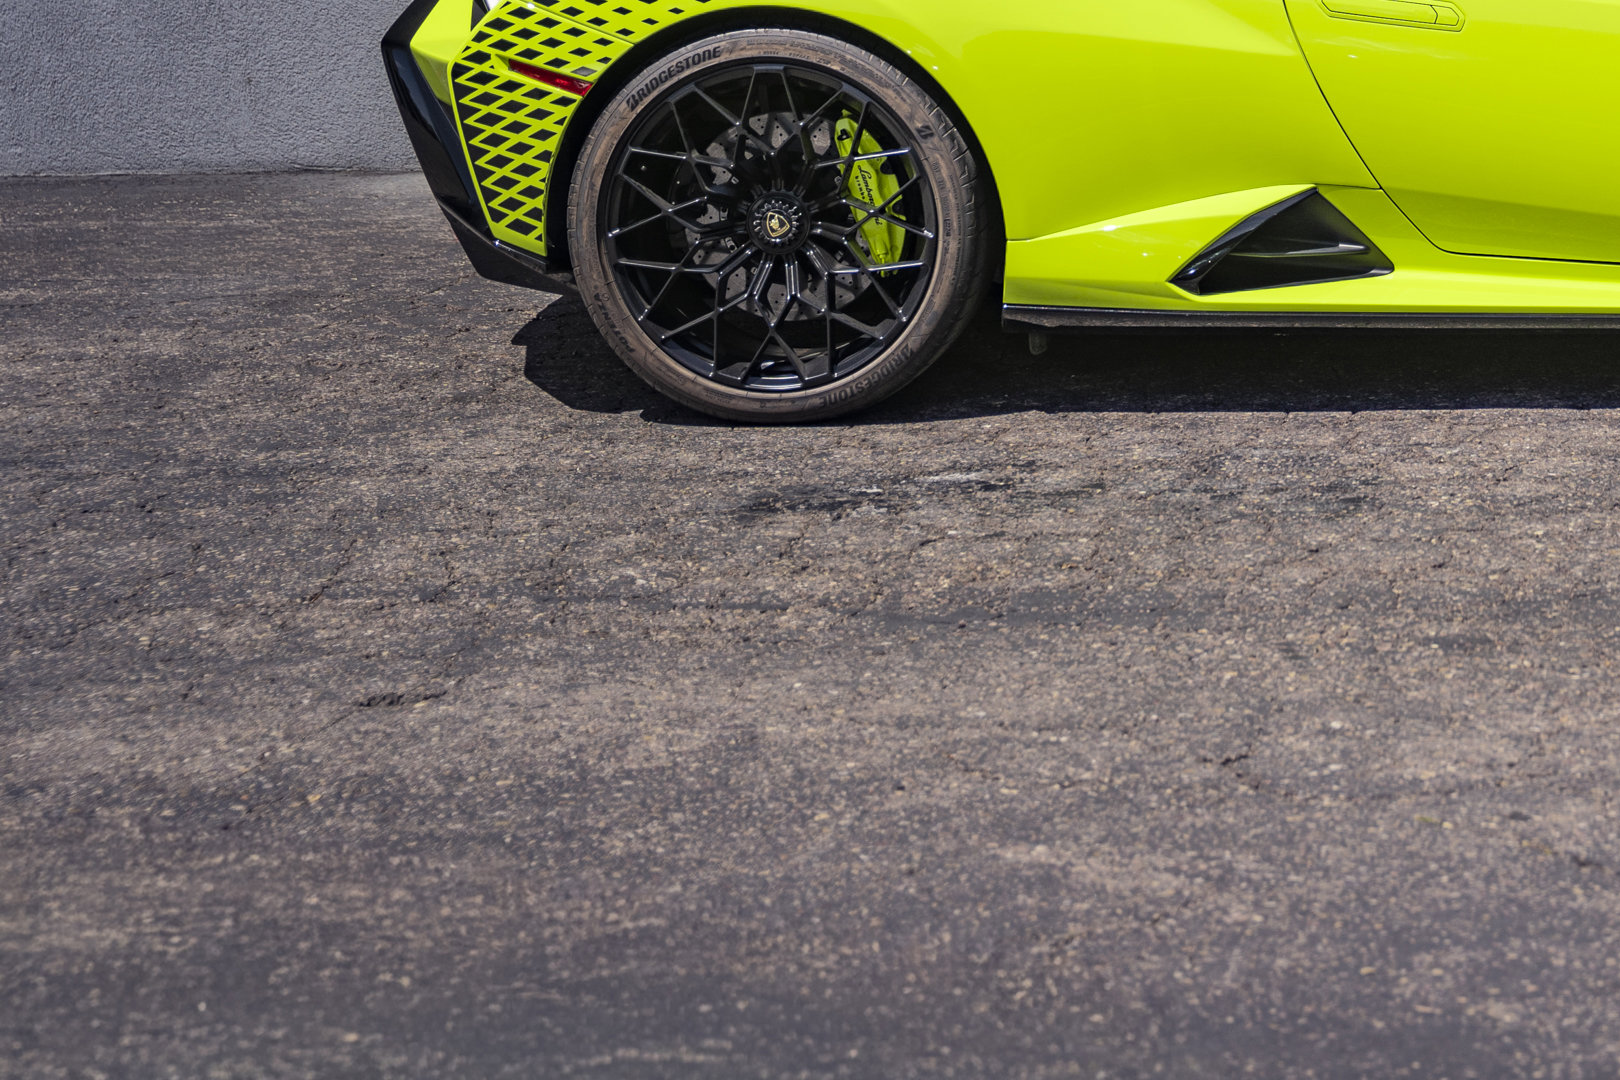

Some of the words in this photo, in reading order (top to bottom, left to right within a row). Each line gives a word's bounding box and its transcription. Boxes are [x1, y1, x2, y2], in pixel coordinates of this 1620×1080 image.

[625, 46, 721, 112] BRIDGESTONE
[857, 164, 883, 226] Lamborni
[819, 344, 913, 407] BRIDGESTONE
